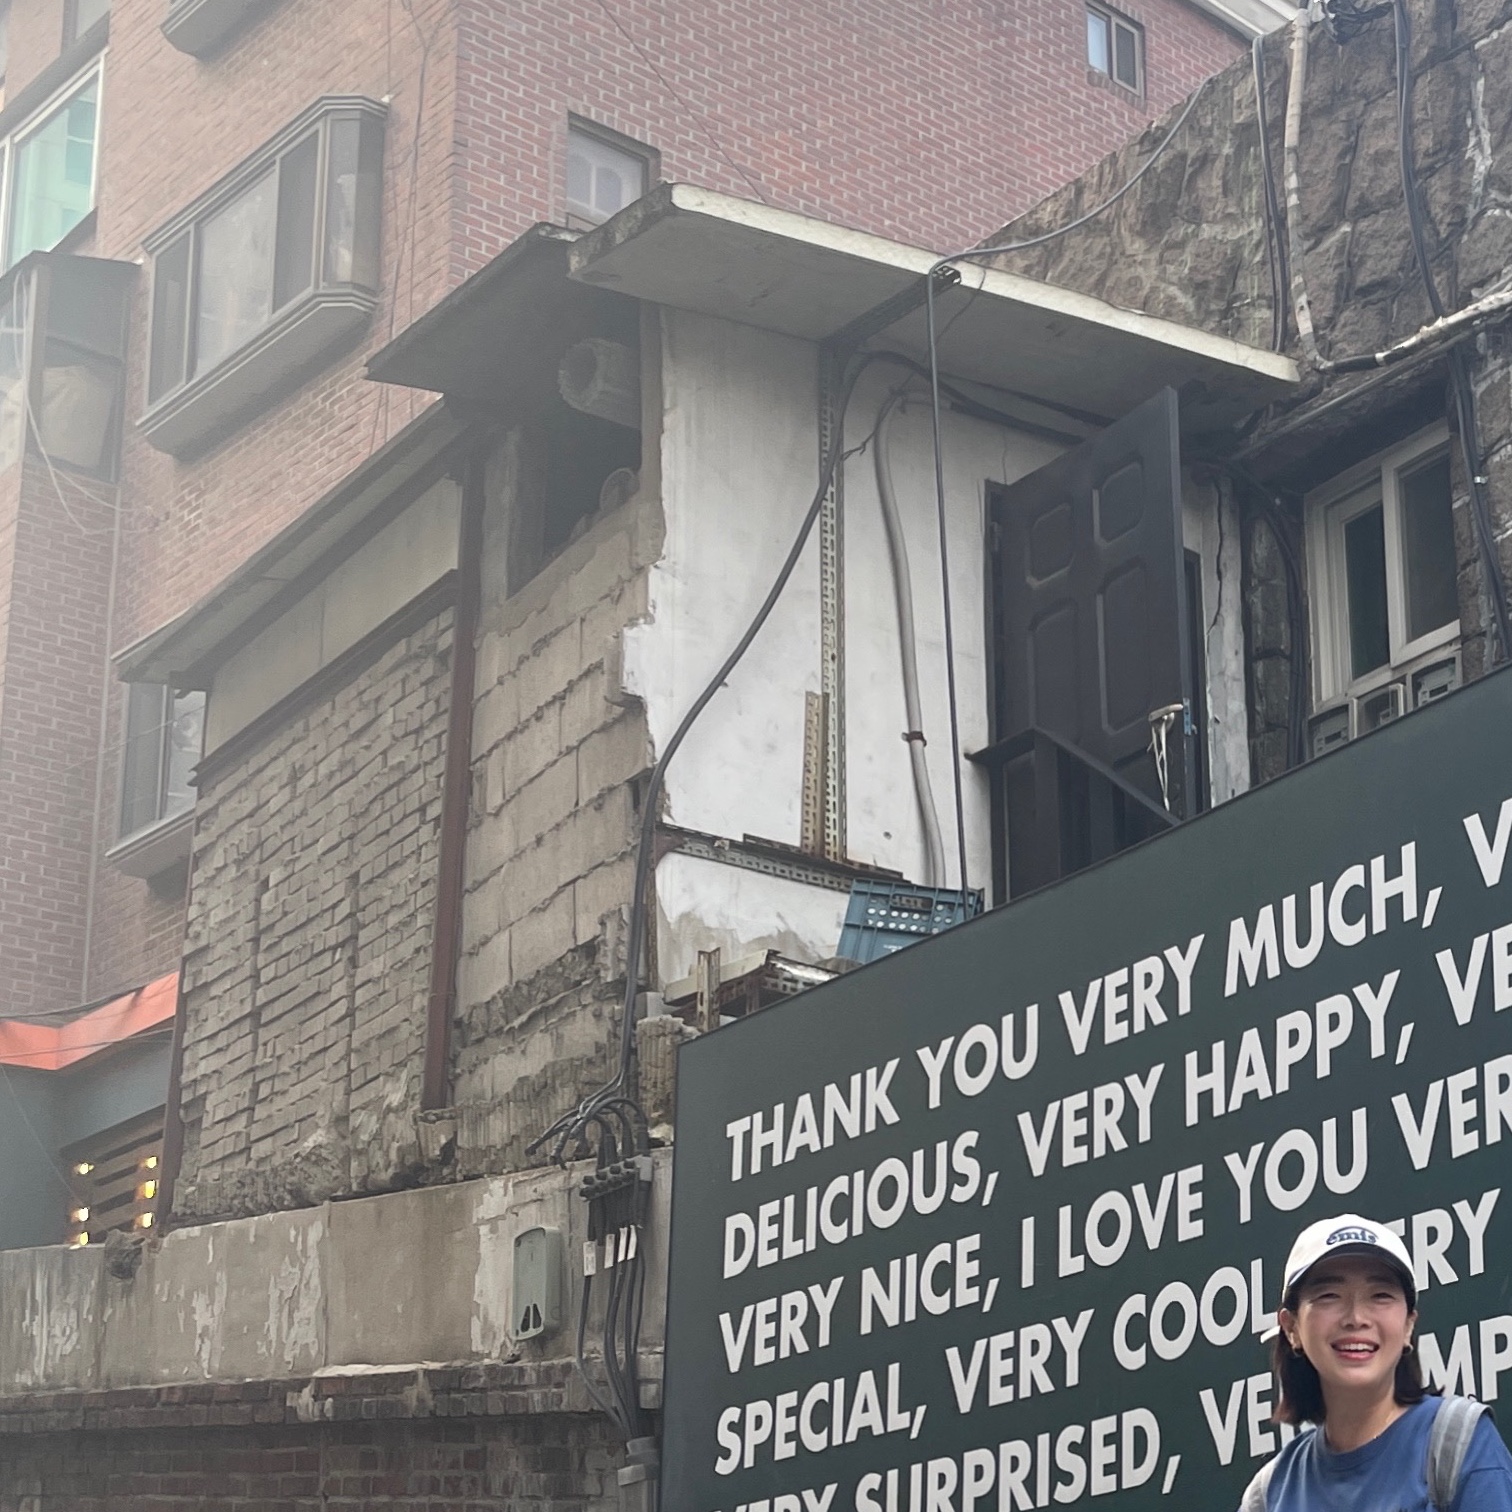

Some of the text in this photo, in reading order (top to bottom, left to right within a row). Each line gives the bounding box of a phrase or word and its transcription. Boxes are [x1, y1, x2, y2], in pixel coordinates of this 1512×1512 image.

[723, 1131, 1000, 1279] DELICIOUS,
[1018, 1063, 1164, 1178] VERY
[1185, 970, 1414, 1128] HAPPY,
[726, 1058, 900, 1181] THANK
[917, 1005, 1038, 1109] YOU
[1059, 934, 1204, 1056] VERY
[1224, 841, 1442, 997] MUCH,
[719, 1276, 843, 1373] VERY
[861, 1233, 1000, 1336] NICE,
[1022, 1217, 1035, 1289] I
[1058, 1164, 1203, 1279] LOVE
[1224, 1107, 1367, 1225] YOU
[714, 1363, 927, 1476] SPECIAL,
[946, 1309, 1094, 1414] VERY
